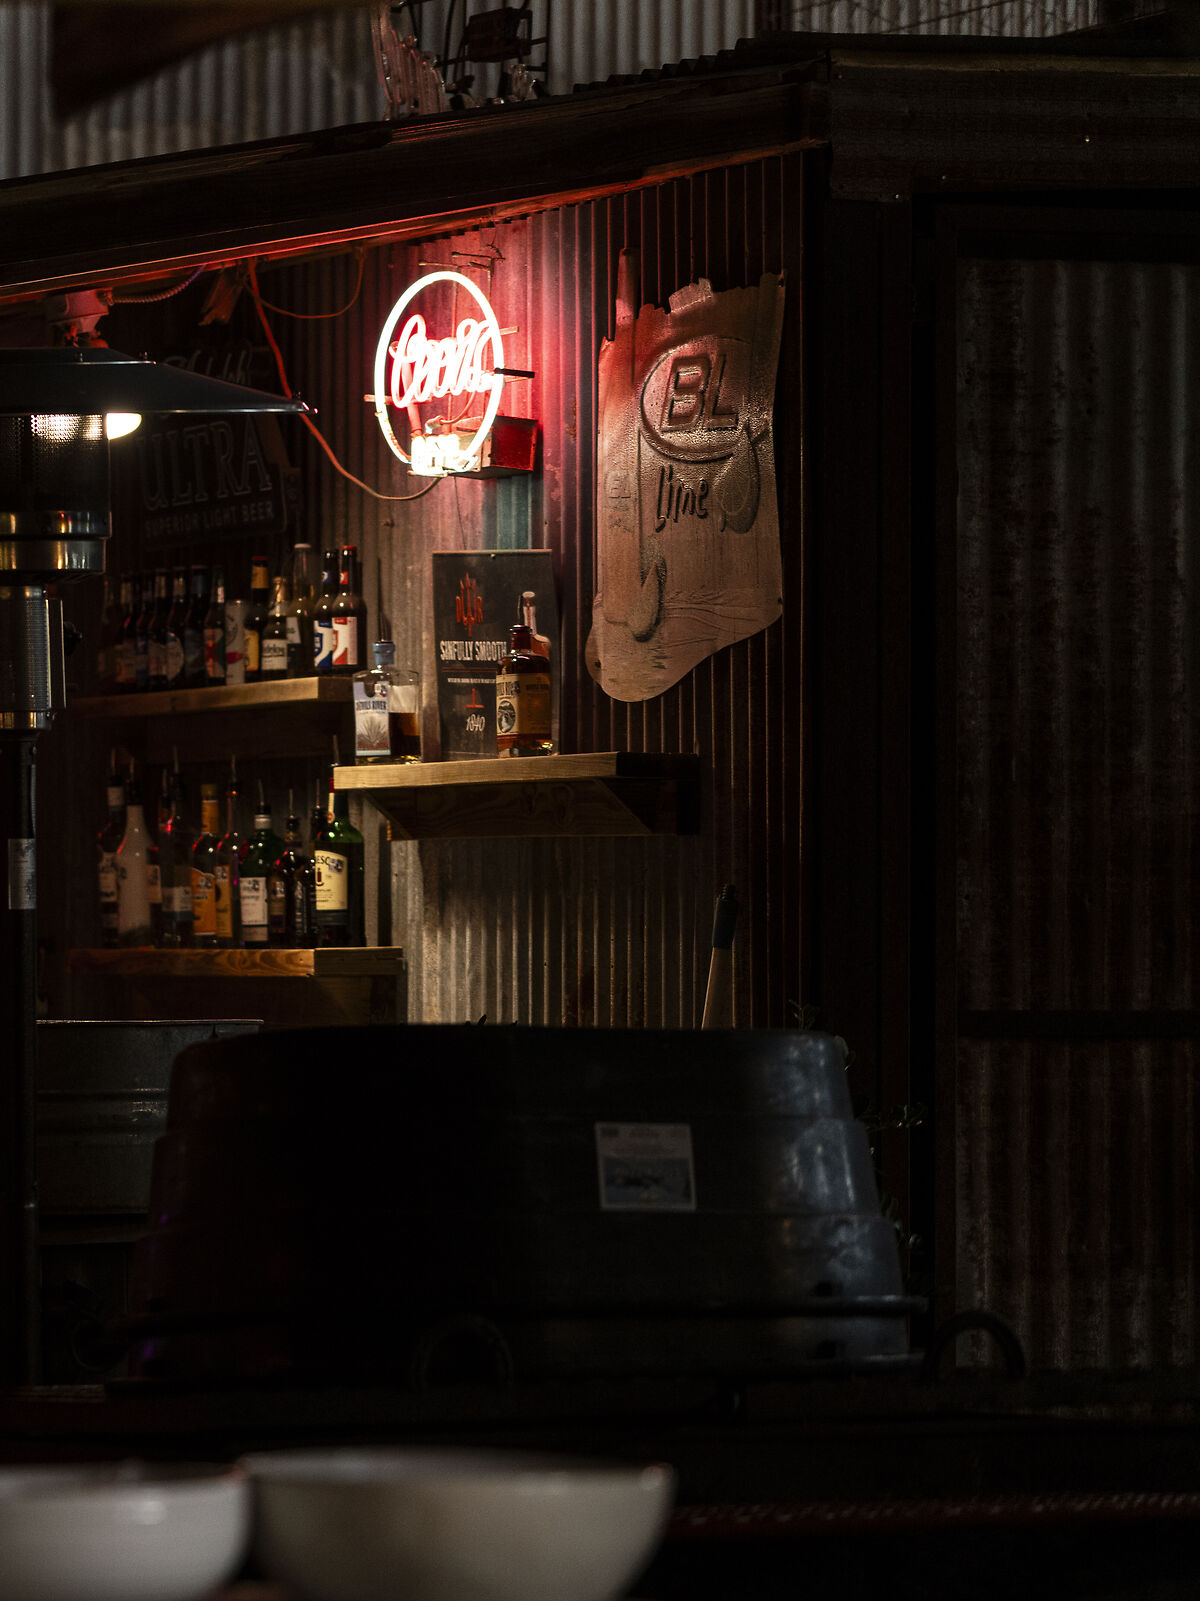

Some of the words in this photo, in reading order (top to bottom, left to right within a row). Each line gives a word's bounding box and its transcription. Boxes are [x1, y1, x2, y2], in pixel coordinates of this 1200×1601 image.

[660, 354, 739, 433] BL
[144, 413, 273, 512] ULTRA
[242, 501, 274, 522] BEER
[475, 641, 507, 661] SMOOTH
[465, 713, 486, 732] 1840
